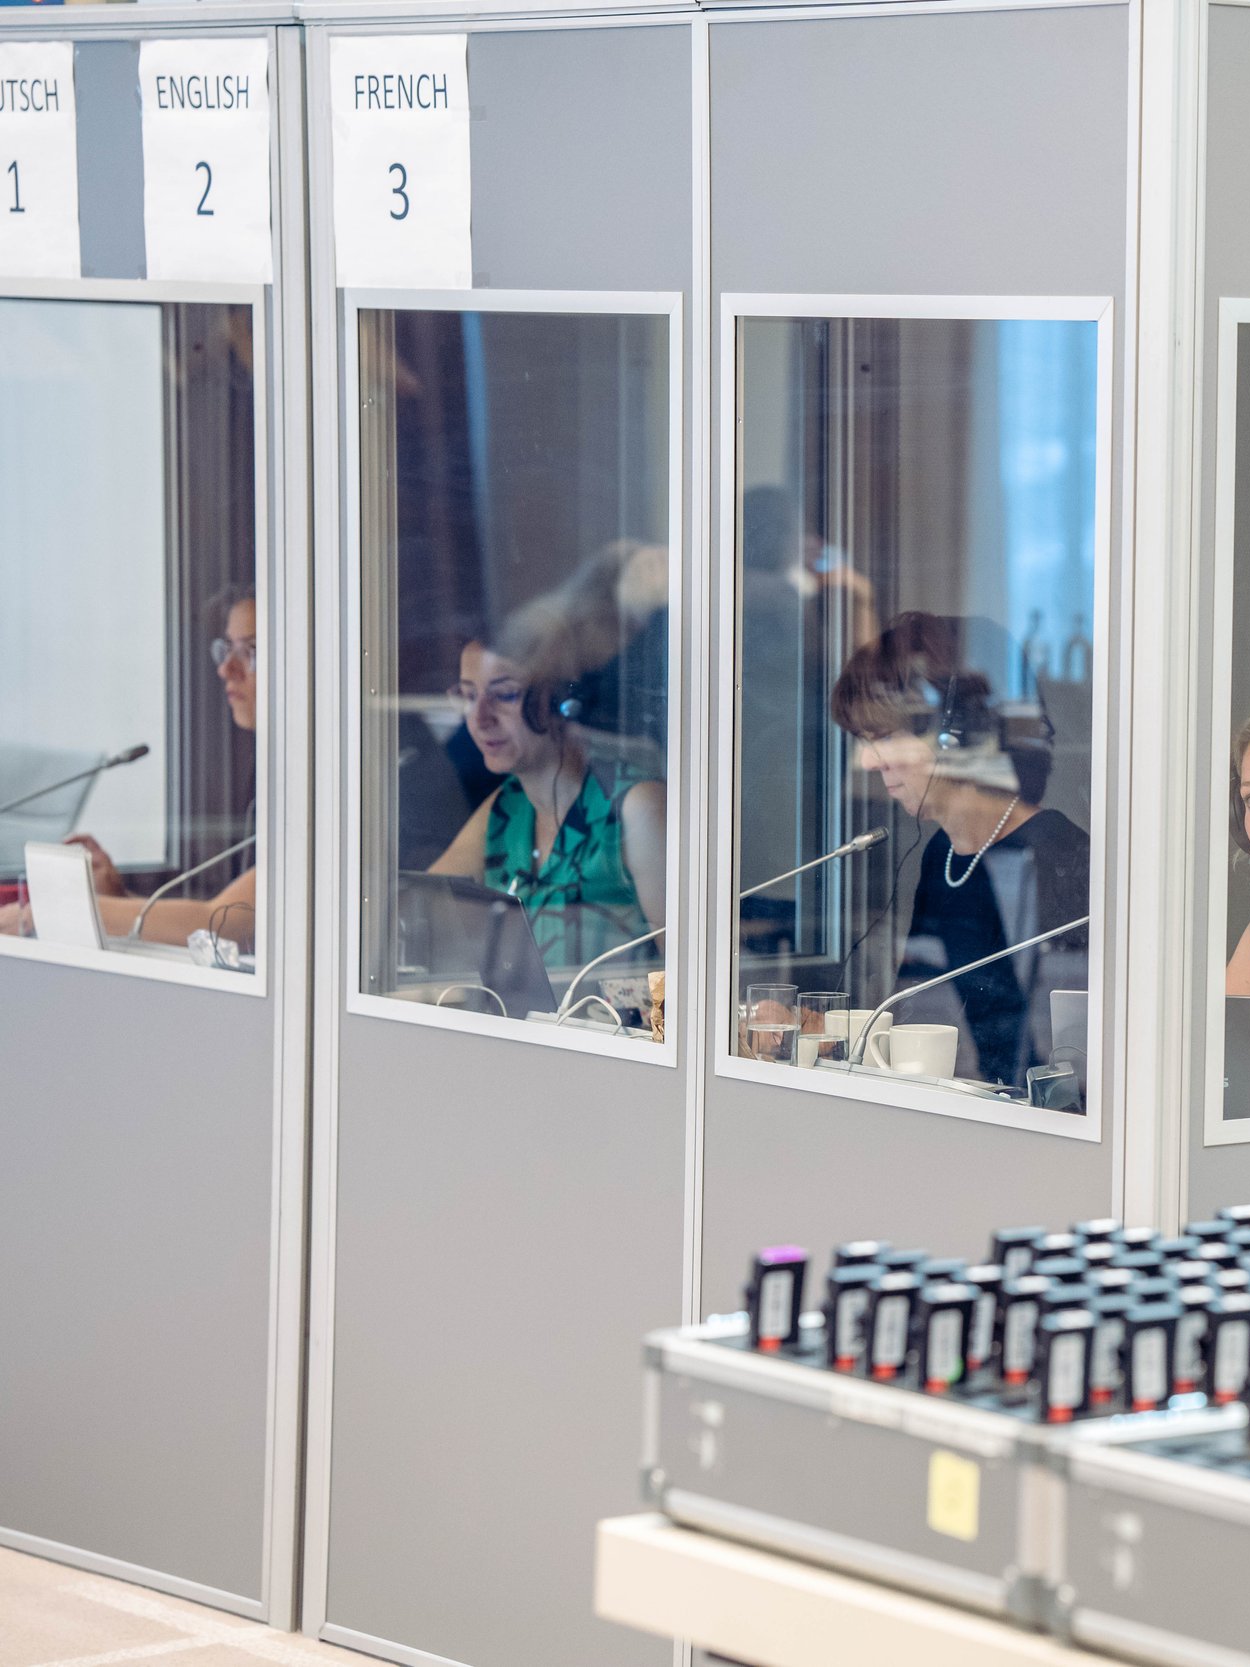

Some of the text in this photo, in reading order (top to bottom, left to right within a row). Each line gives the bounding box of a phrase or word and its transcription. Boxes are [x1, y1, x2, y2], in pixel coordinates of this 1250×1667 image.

[157, 75, 249, 110] ENGLISH
[355, 74, 448, 110] FRENCH
[8, 160, 26, 213] 1
[195, 161, 215, 216] 2
[388, 162, 410, 220] 3
